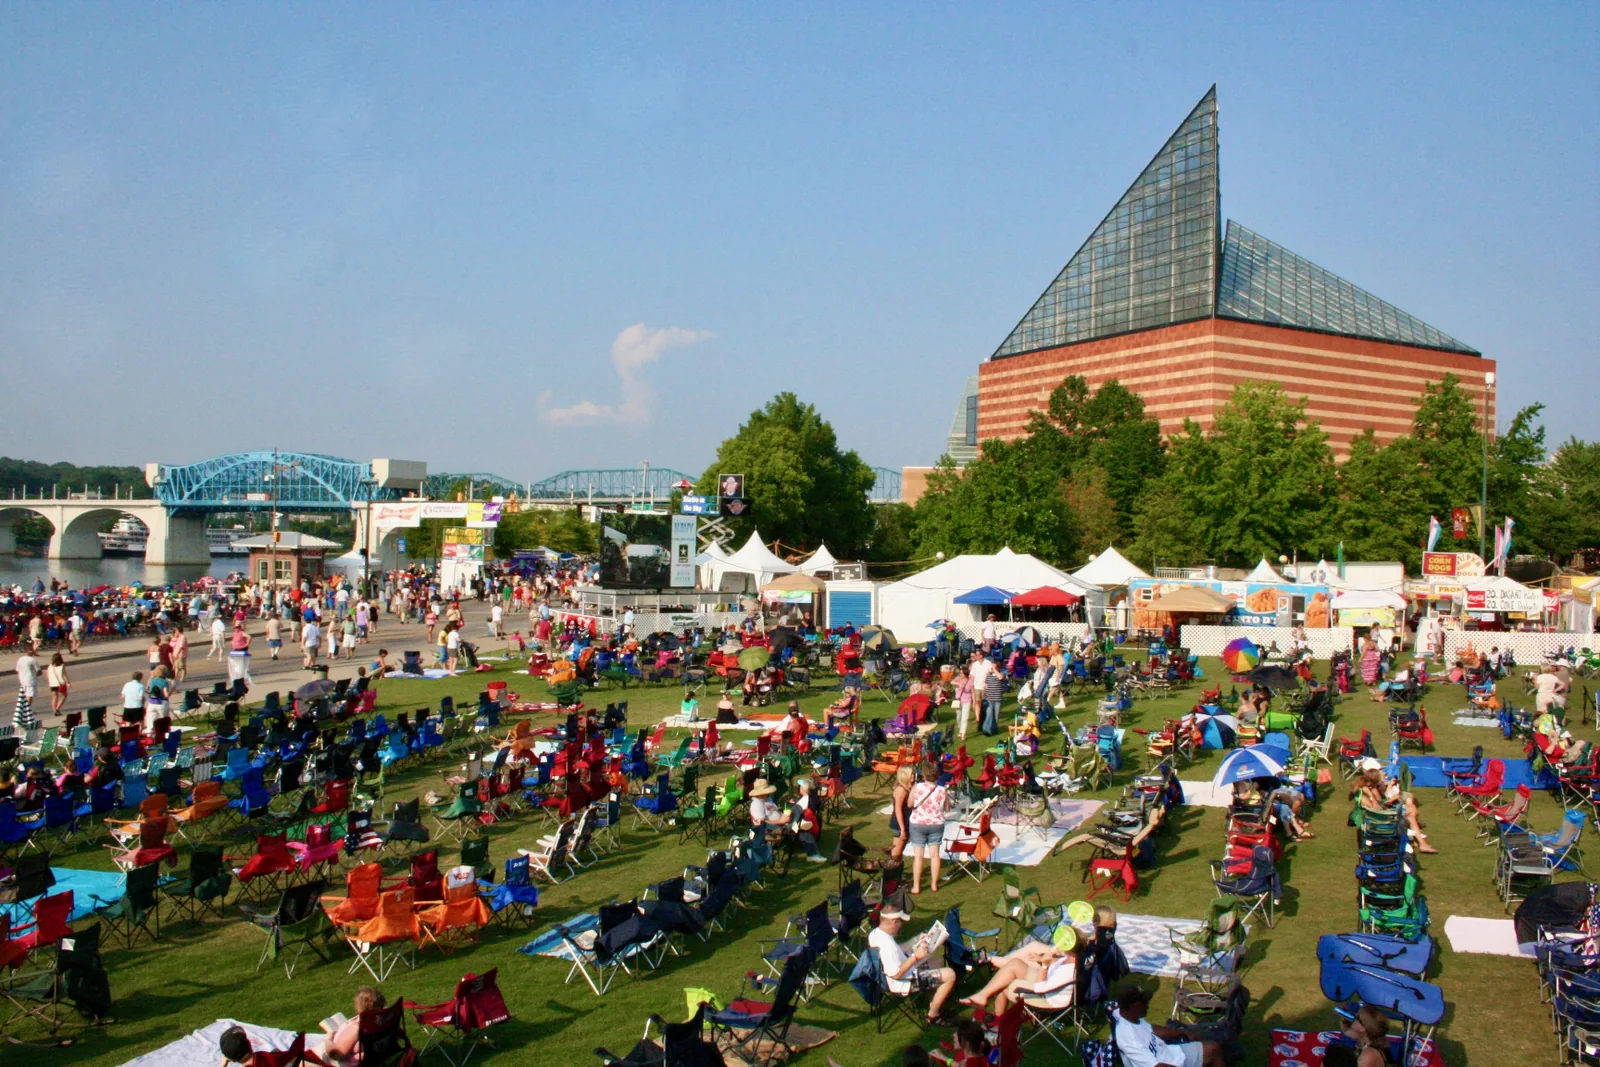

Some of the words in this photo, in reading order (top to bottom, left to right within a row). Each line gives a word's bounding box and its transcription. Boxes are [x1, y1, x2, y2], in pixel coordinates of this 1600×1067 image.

[692, 505, 702, 513] Sky
[1206, 614, 1231, 622] DIVE
[1233, 615, 1261, 624] INTO
